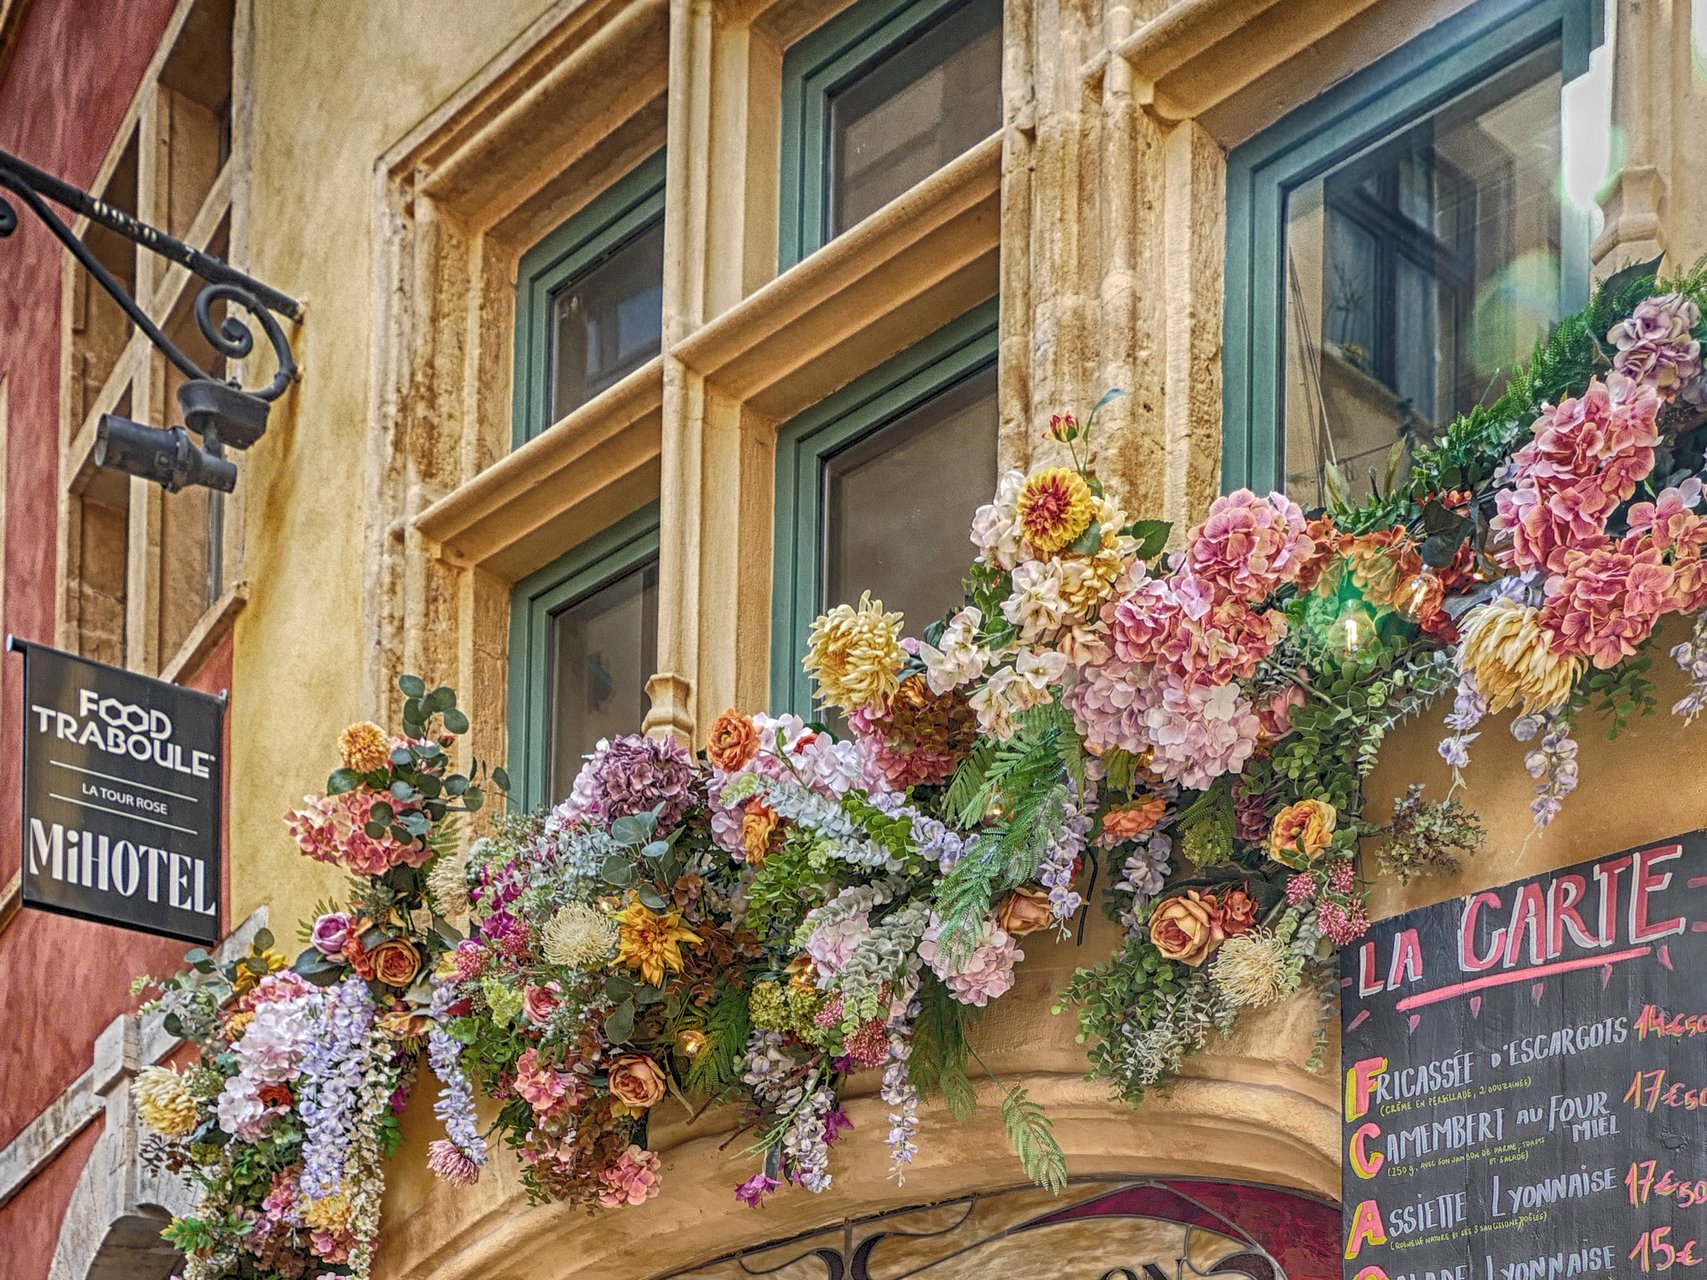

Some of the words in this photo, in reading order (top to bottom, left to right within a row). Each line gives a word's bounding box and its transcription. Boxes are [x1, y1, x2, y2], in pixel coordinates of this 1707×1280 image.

[79, 688, 172, 740] FOOD
[31, 704, 211, 779] TRABOULE
[82, 783, 98, 797] LA
[100, 787, 134, 807] TOUR
[136, 796, 168, 815] ROSE
[1358, 928, 1423, 999] LA
[1457, 844, 1687, 972] CARTE
[1345, 1050, 1475, 1123] FRICASSÉE
[1491, 1016, 1628, 1069] D'ESCARGOTS
[1416, 1099, 1425, 1109] EN
[1479, 1086, 1486, 1096] 2
[1488, 1076, 1532, 1094] DOUZAINES)
[1350, 1107, 1505, 1180] CAMEMBERT
[1516, 1107, 1543, 1125] AU
[1548, 1091, 1611, 1132] FOUR
[1623, 1069, 1707, 1112] 17€50
[1572, 1115, 1621, 1143] MIEL
[1420, 1160, 1436, 1170] AVEC
[1437, 1157, 1450, 1166] SON
[1450, 1152, 1480, 1165] JAMBON
[1481, 1149, 1491, 1158] DE
[1499, 1150, 1529, 1164] SALADE)
[1624, 1160, 1707, 1209] 17€50
[1474, 1224, 1480, 1234] 3
[1628, 1226, 1703, 1273] 15€
